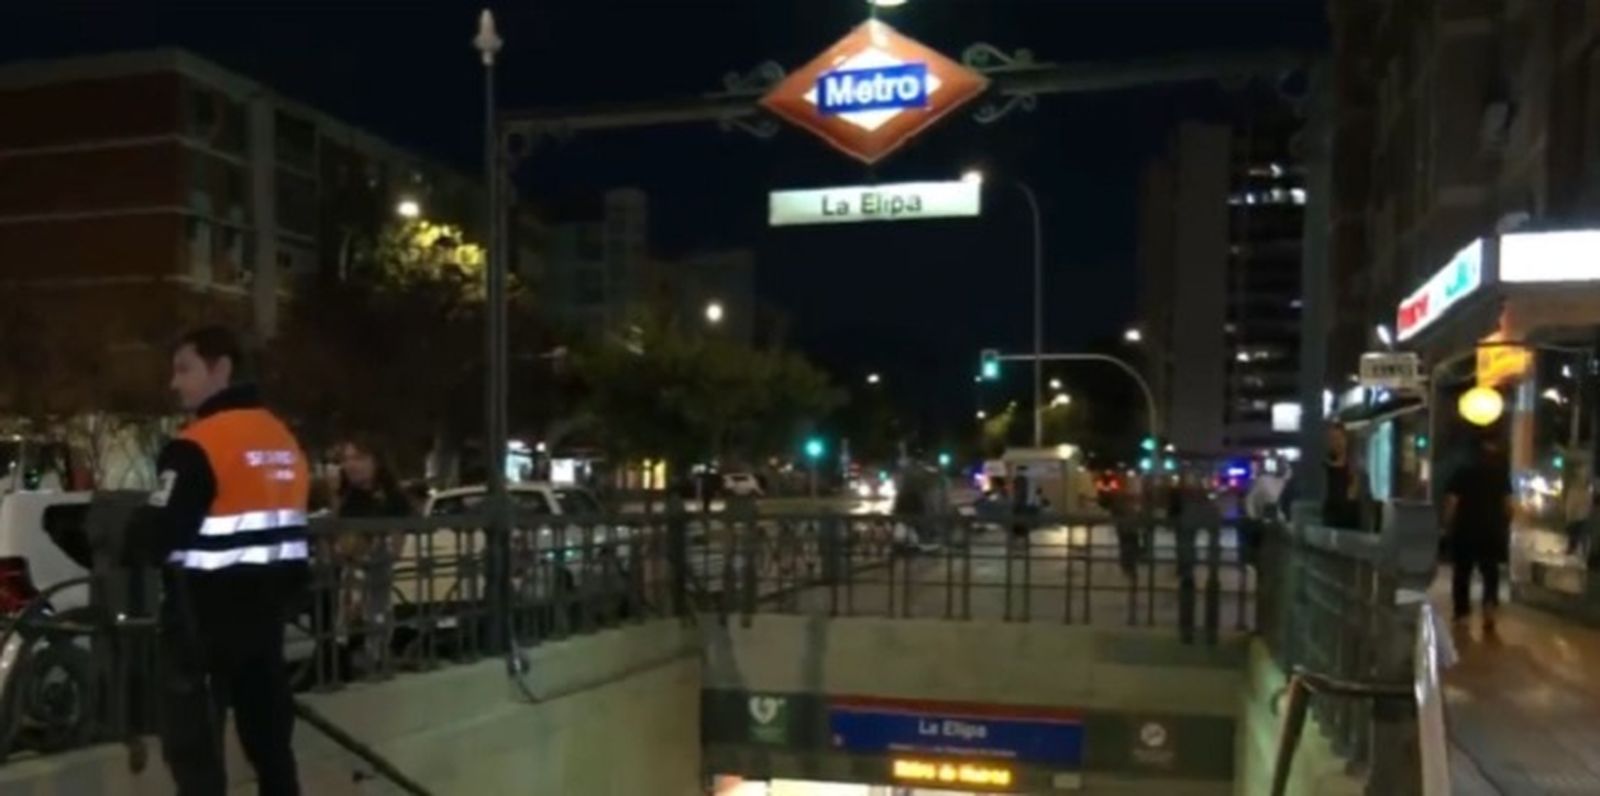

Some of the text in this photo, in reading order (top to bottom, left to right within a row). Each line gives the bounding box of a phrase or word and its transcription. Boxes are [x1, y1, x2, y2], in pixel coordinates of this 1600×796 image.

[825, 72, 920, 106] Metro
[822, 193, 922, 216] La Elipa
[918, 719, 988, 740] La Elipa
